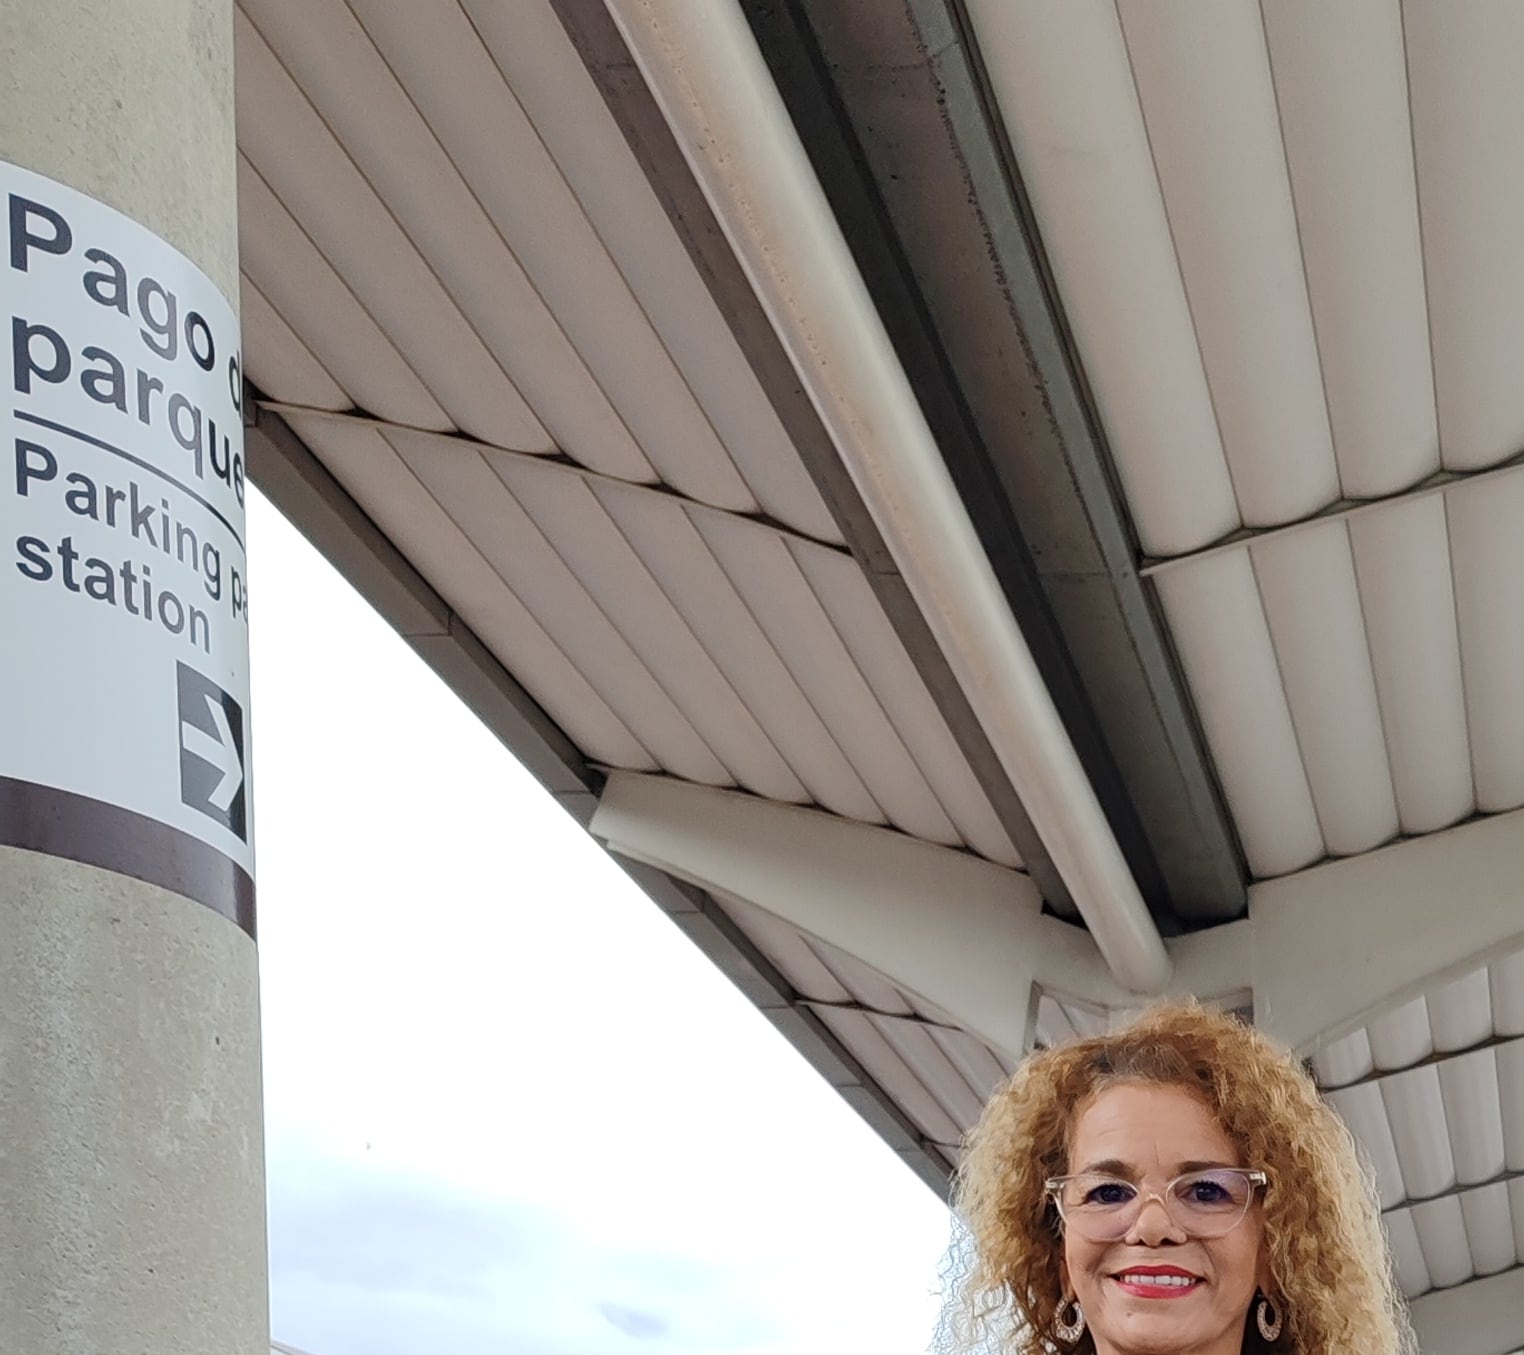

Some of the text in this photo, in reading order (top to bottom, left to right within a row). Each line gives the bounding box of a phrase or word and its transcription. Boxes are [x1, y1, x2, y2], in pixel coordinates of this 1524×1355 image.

[7, 193, 217, 371] Pago
[12, 315, 246, 510] parque
[13, 438, 221, 602] Parking
[15, 534, 212, 655] station
